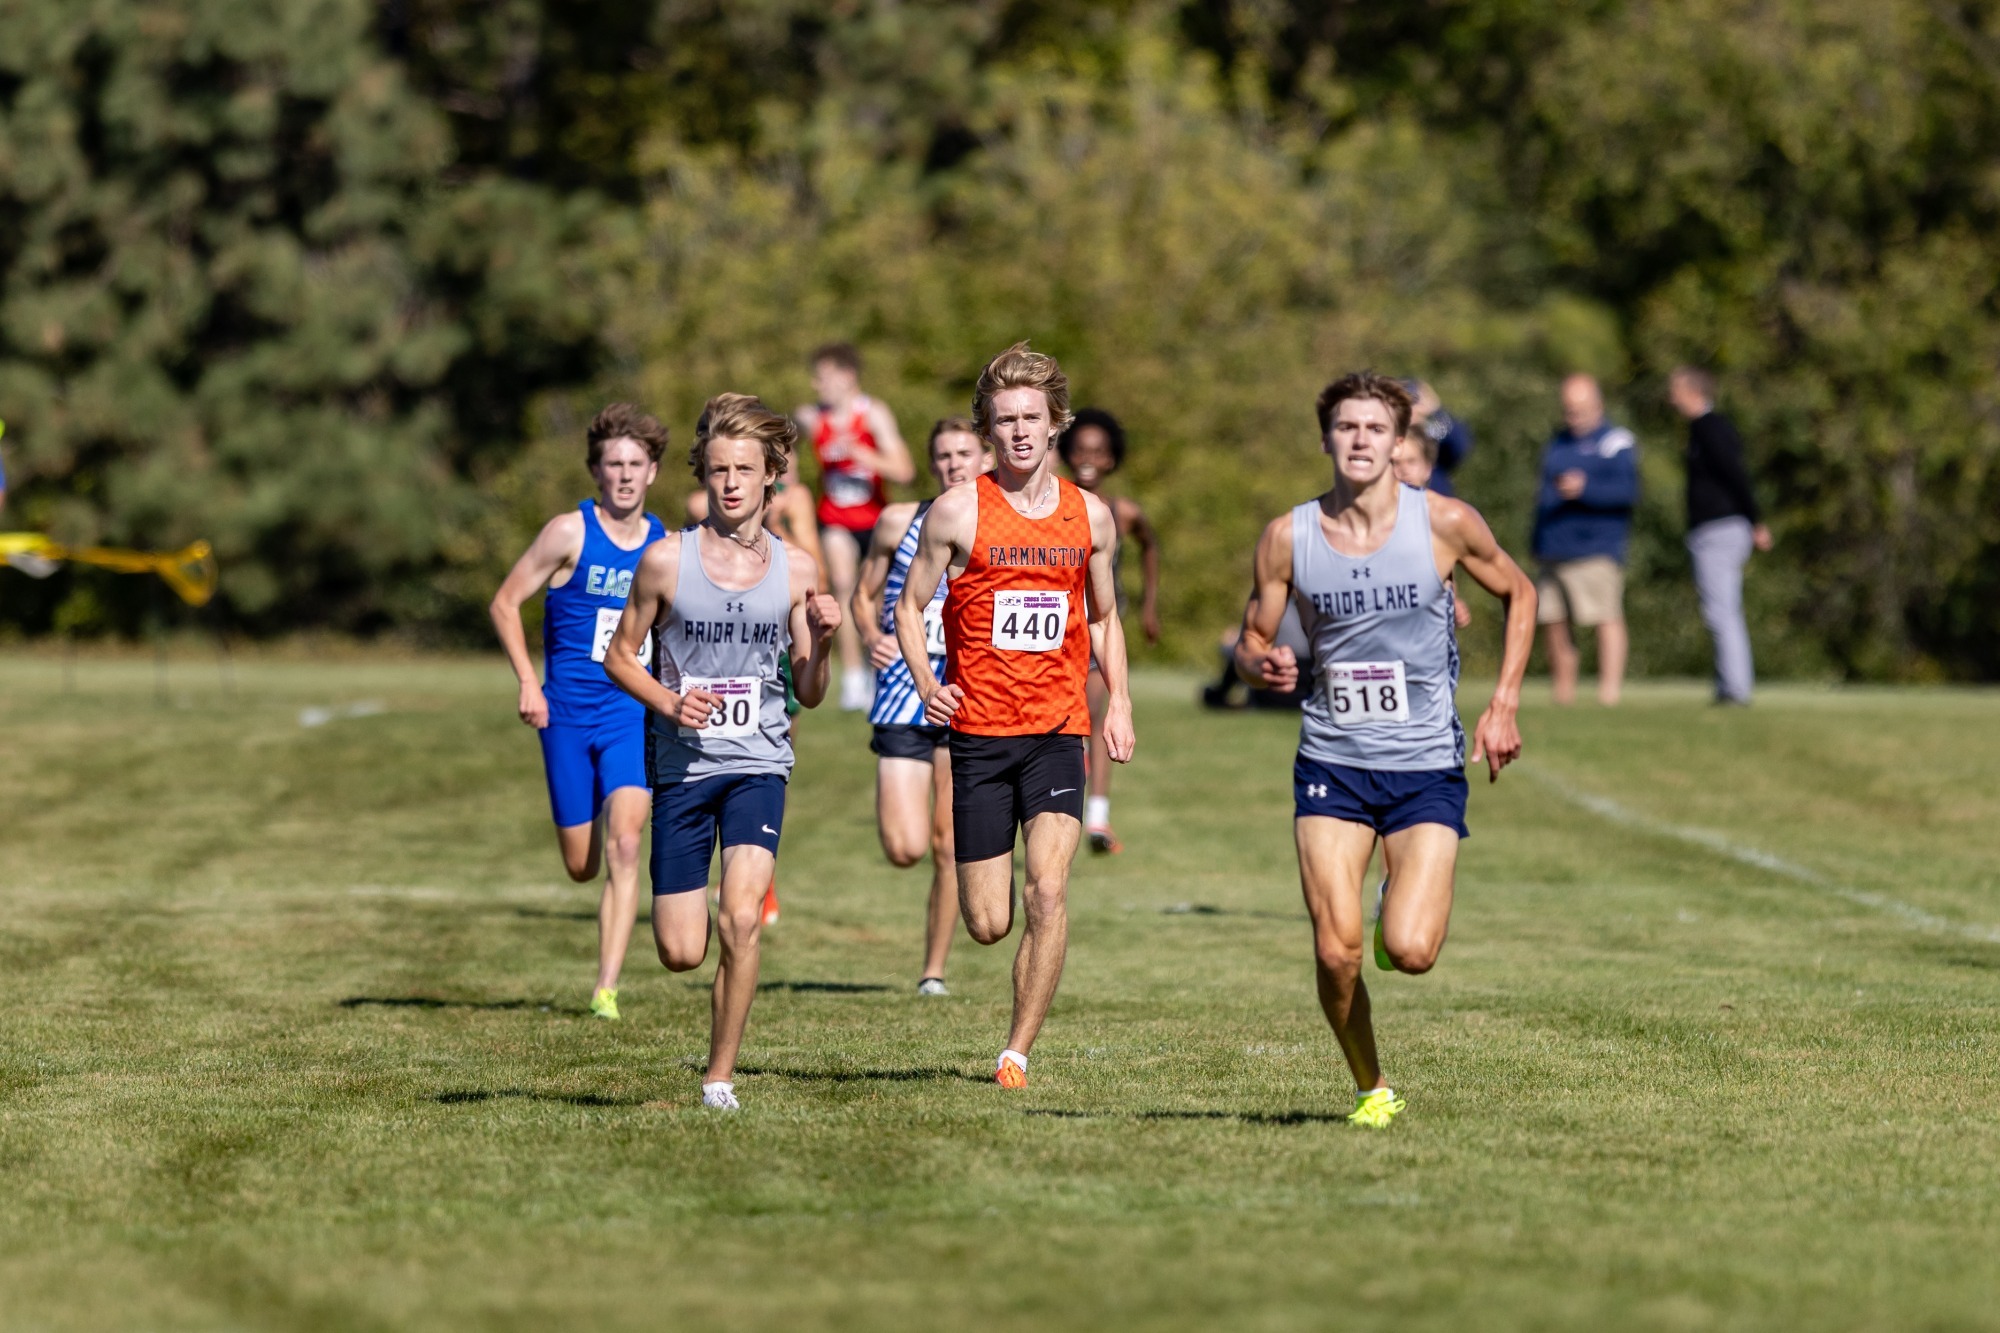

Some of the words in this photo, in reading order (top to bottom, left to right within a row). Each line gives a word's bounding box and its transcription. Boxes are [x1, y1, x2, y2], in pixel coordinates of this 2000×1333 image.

[989, 547, 1086, 567] FARMINGTON
[586, 565, 634, 598] EAG
[1312, 590, 1366, 616] PRIOR
[1373, 584, 1419, 611] LAKE
[684, 620, 735, 643] PRIOR
[740, 622, 778, 645] LAKE
[1001, 612, 1060, 641] 440
[710, 699, 750, 727] 30
[1333, 685, 1398, 713] 518
